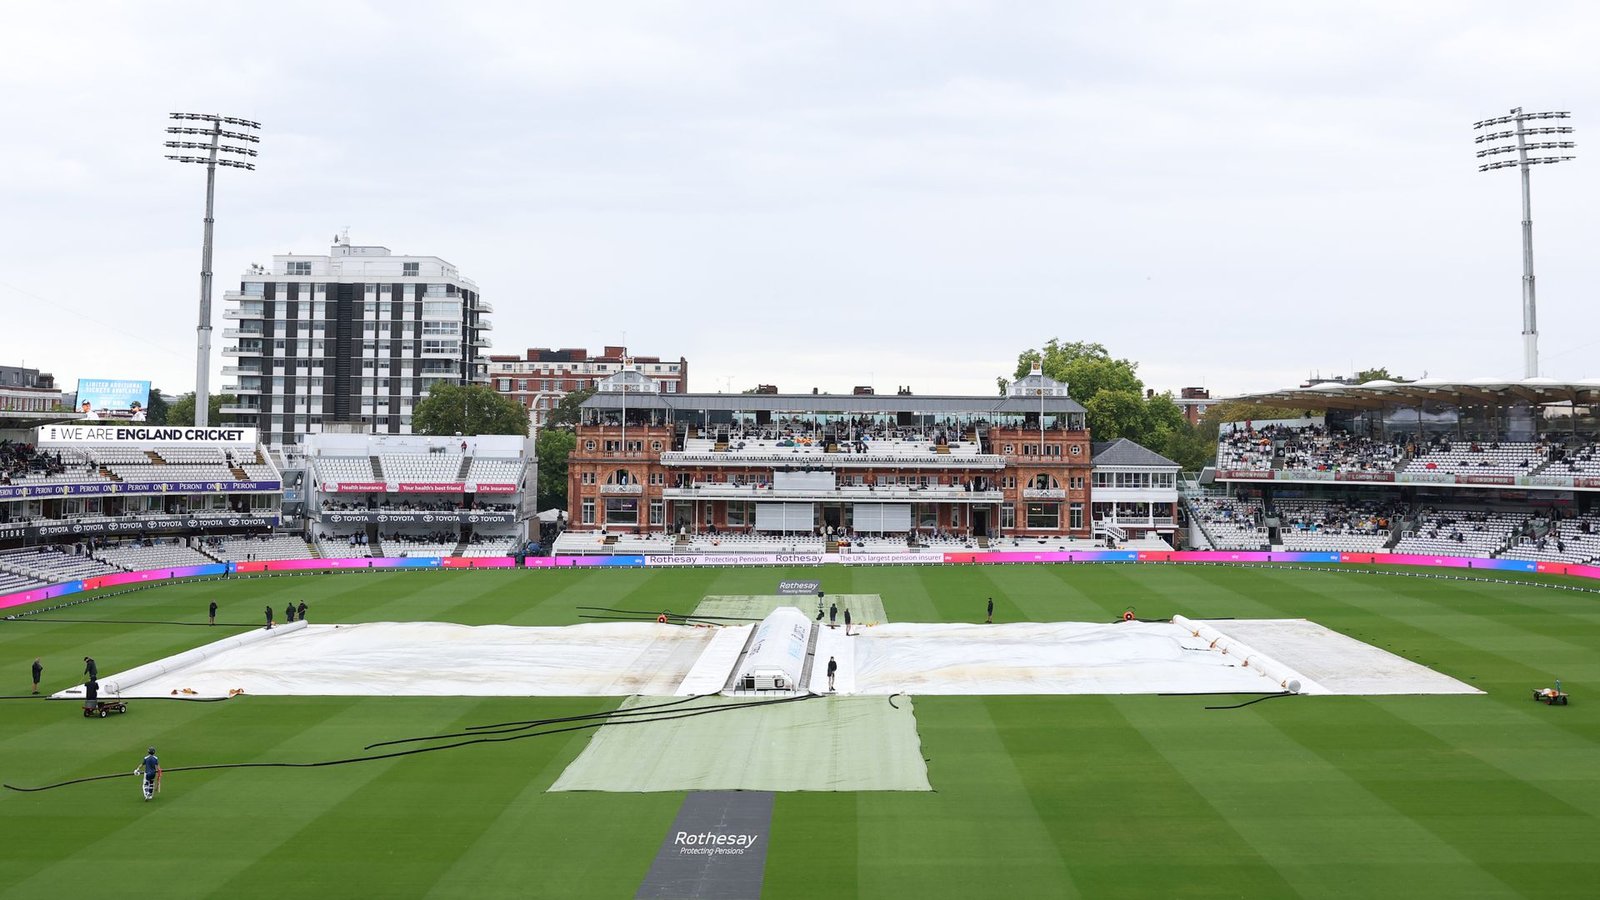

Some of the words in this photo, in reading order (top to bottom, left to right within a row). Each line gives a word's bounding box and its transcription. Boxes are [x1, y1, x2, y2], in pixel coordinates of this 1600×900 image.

[61, 428, 82, 440] WE
[86, 428, 114, 440] ARE
[116, 429, 182, 440] ENGLAND
[185, 430, 244, 440] CRICKET
[650, 555, 698, 564] Rothesay
[776, 554, 823, 562] Rothesay
[868, 555, 890, 563] largest
[674, 832, 758, 848] Rothesay
[680, 847, 714, 856] Protecting
